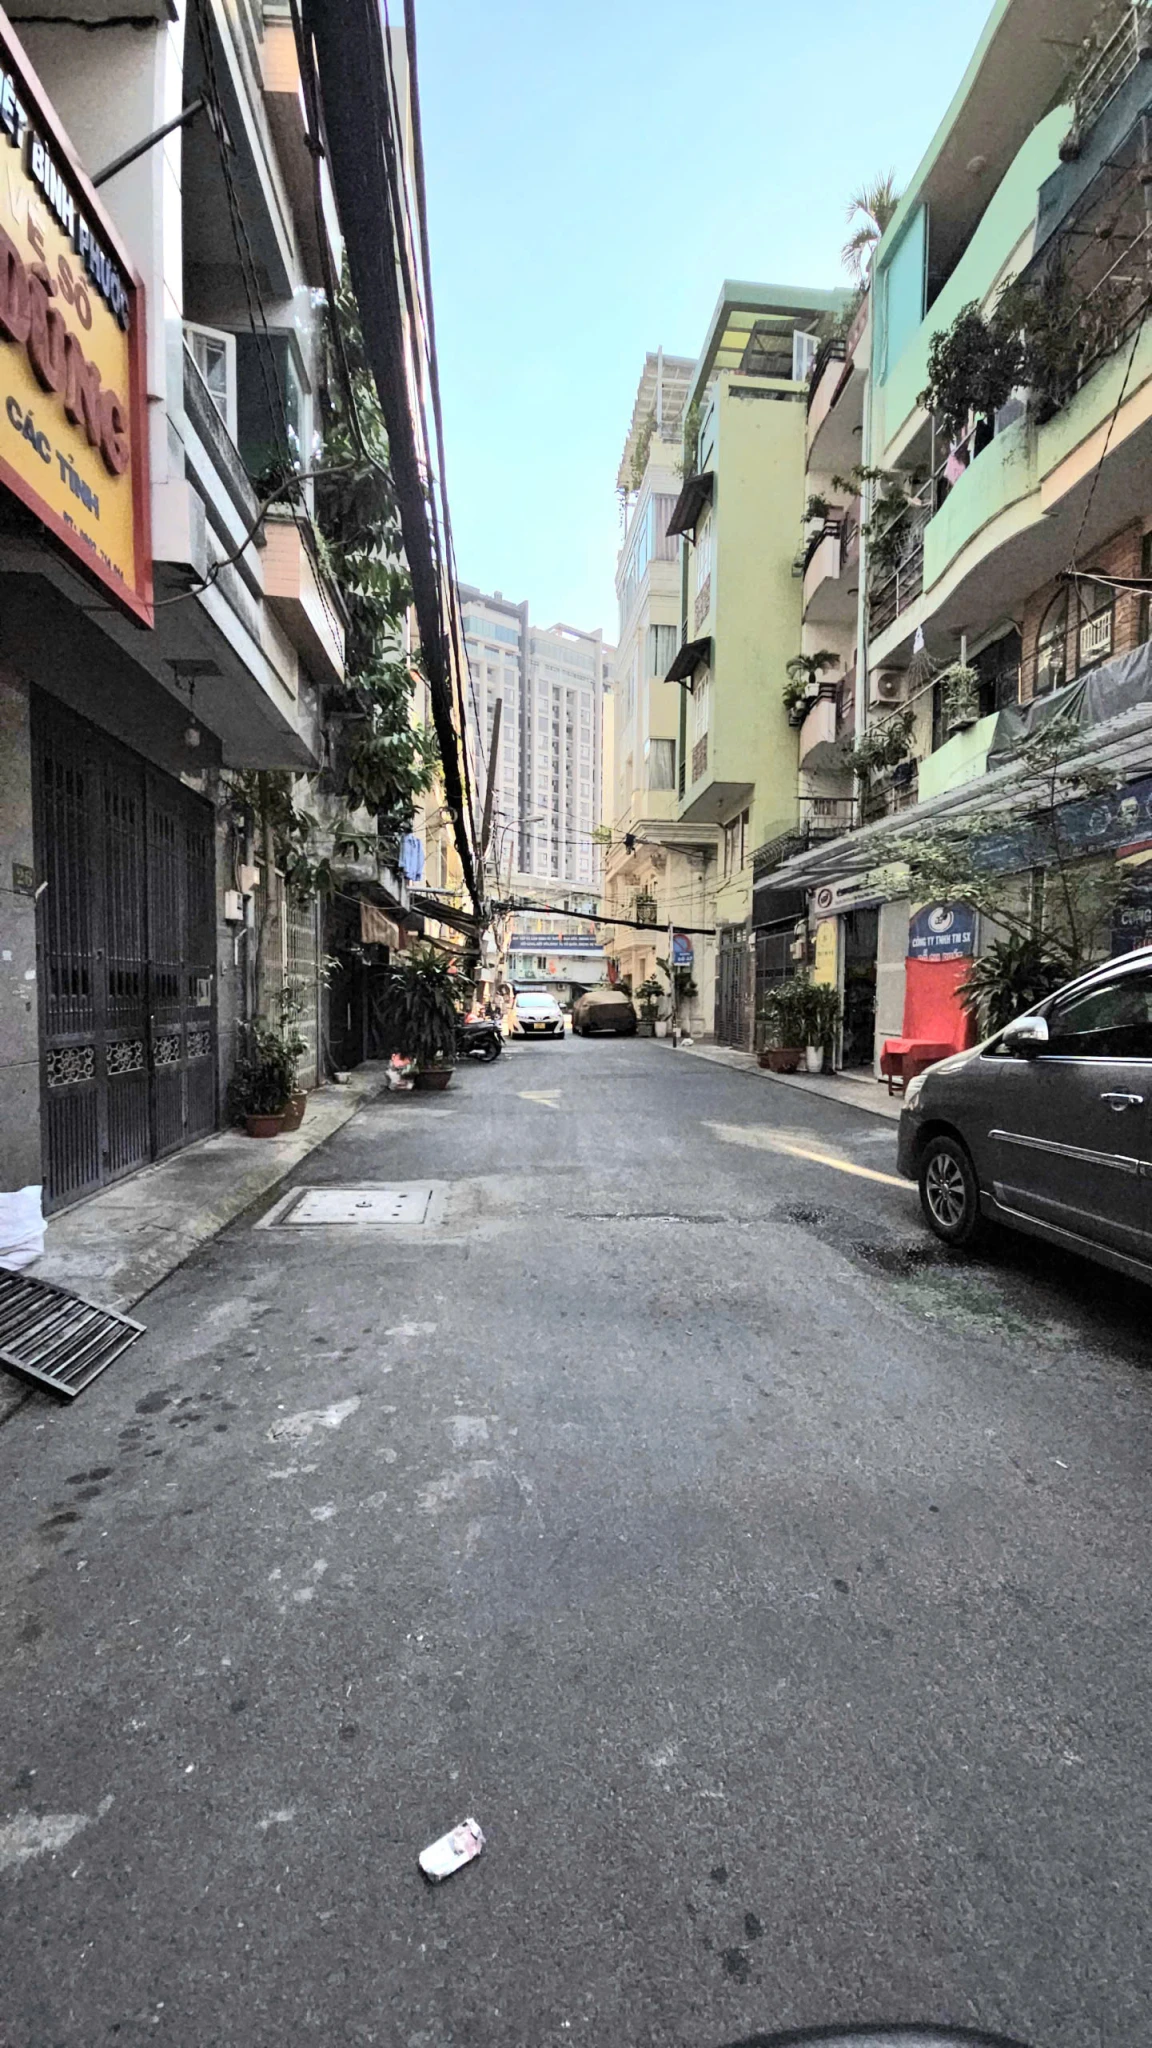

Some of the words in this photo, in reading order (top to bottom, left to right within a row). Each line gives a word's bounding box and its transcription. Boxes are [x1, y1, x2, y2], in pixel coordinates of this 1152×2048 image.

[32, 130, 75, 237] BÌNH
[58, 254, 92, 331] SỐ
[6, 395, 51, 464] CÁC
[55, 449, 100, 520] TỈNH
[912, 938, 927, 947] CÔNG
[927, 936, 935, 946] TY
[936, 935, 951, 945] TNHH
[962, 932, 971, 942] SX
